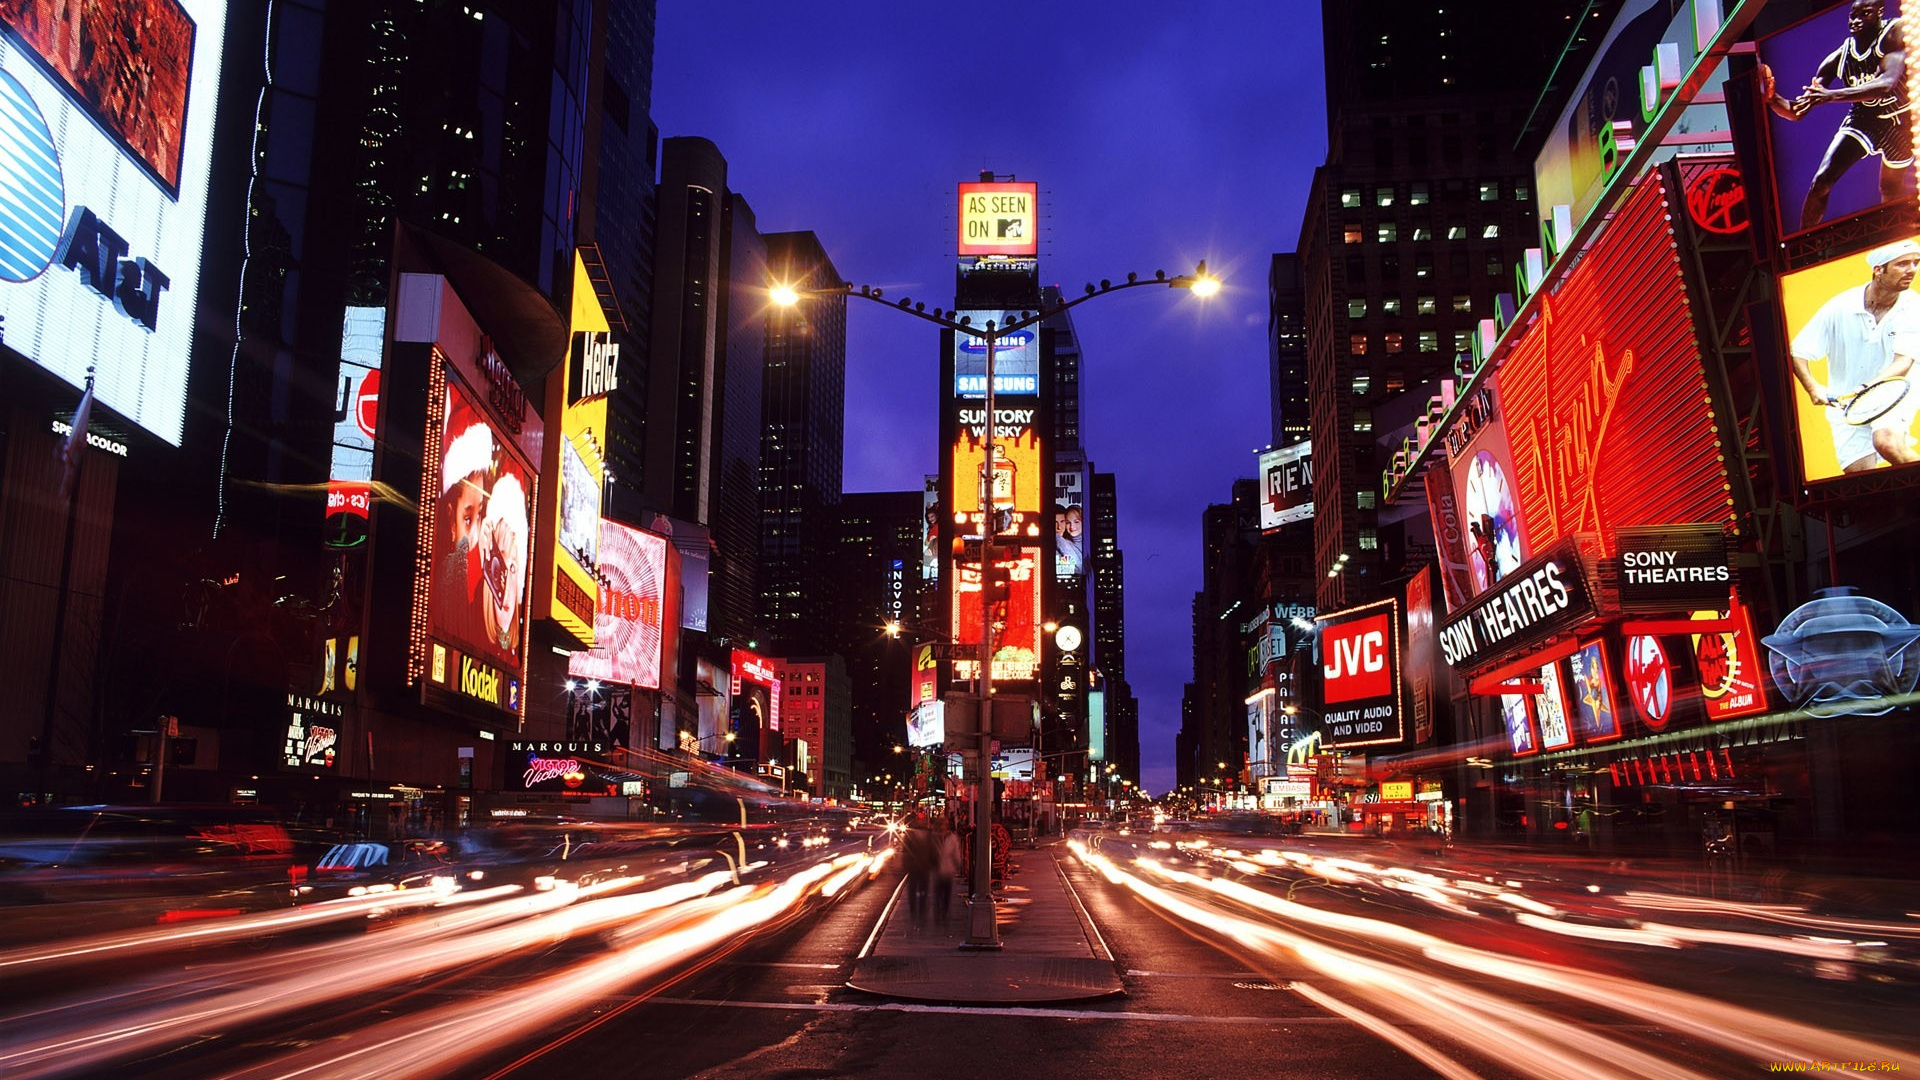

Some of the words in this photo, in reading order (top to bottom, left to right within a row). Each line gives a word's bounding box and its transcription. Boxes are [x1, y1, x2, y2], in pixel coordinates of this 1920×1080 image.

[969, 197, 986, 213] AS
[991, 196, 1026, 213] SEEN
[968, 220, 989, 238] ON
[997, 219, 1023, 238] MTV
[50, 205, 170, 334] AT&T
[968, 336, 1026, 346] SASUNG
[582, 331, 620, 398] Hertz
[52, 420, 128, 458] SPEACOLOR
[971, 426, 1023, 438] WISKY
[1269, 461, 1313, 496] REN
[1056, 486, 1069, 499] OUT
[1623, 551, 1678, 567] SONY
[1625, 565, 1730, 584] THEATRES
[597, 585, 658, 628] non
[893, 571, 902, 639] NOVOTEL
[1274, 606, 1316, 619] WEBB
[1439, 615, 1478, 666] SONY
[1474, 560, 1569, 648] THEATRES
[694, 617, 706, 628] Lee
[934, 645, 944, 660] W
[948, 646, 963, 660] 45
[1324, 630, 1383, 680] JVC
[461, 655, 499, 704] Kodak
[287, 693, 342, 717] MARQUIS
[1719, 701, 1729, 710] THE
[1729, 693, 1753, 709] ALBUM
[1279, 672, 1289, 753] PALACE
[1324, 710, 1360, 724] QUALITY
[1364, 705, 1392, 719] AUDIO
[1333, 724, 1352, 737] AND
[1355, 721, 1383, 734] VIDEO
[512, 742, 602, 752] MARQUIS
[530, 759, 578, 771] VICTOR
